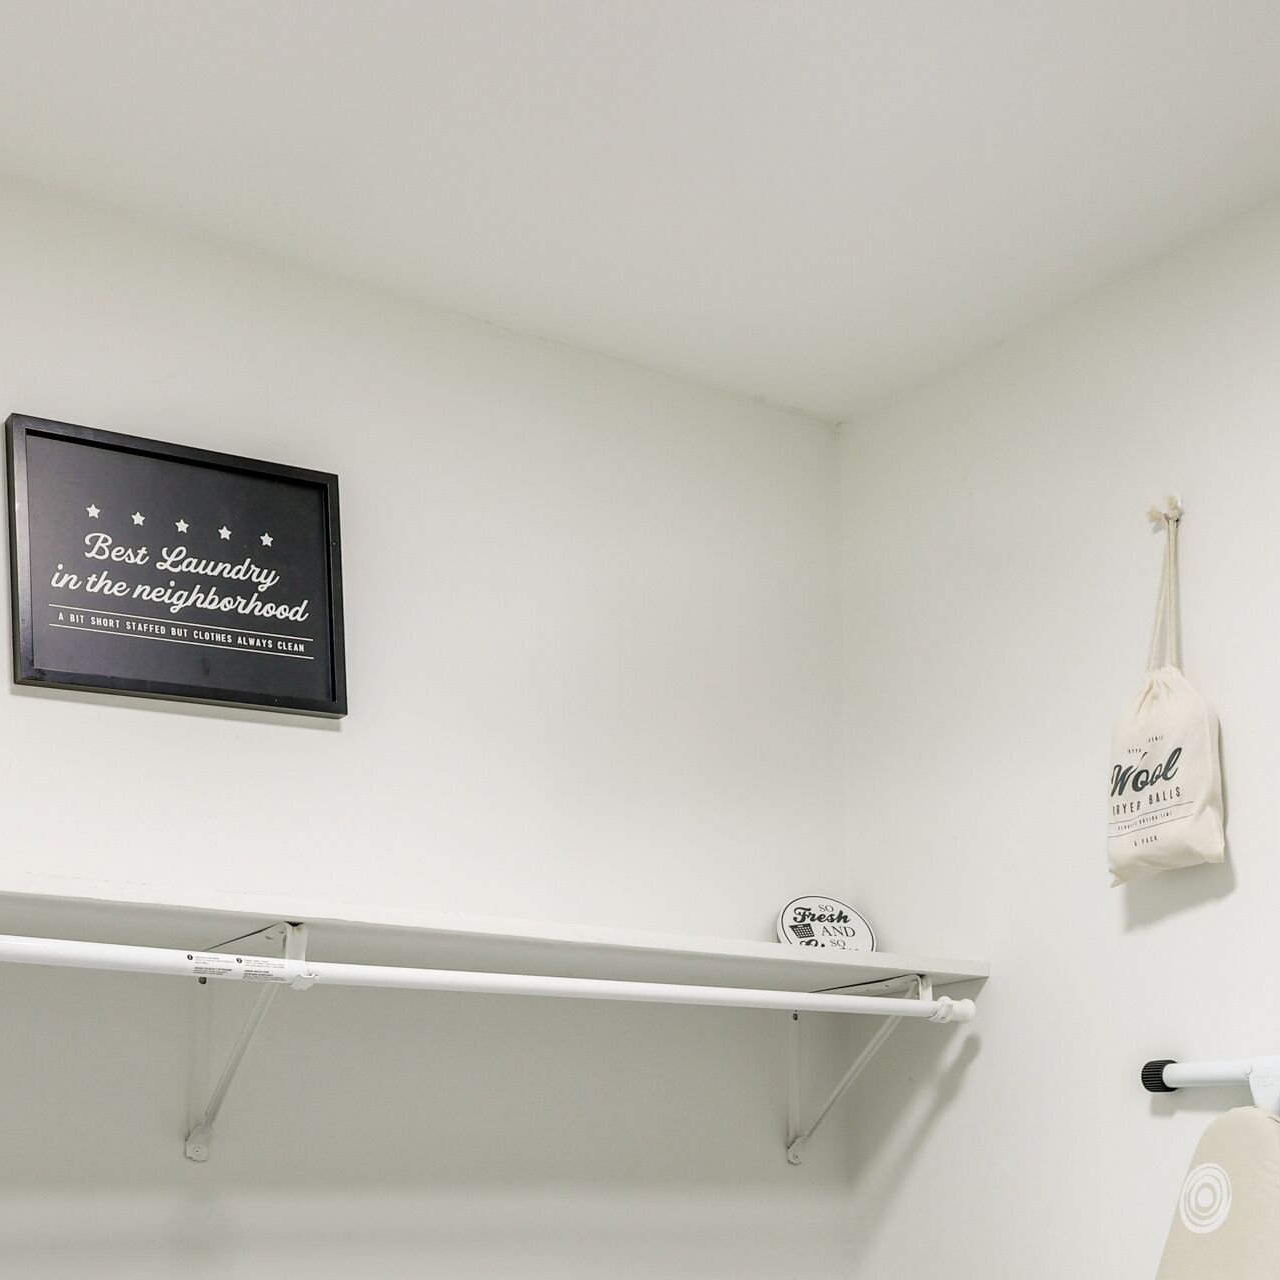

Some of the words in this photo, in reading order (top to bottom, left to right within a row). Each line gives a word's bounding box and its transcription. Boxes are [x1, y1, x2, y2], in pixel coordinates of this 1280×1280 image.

[84, 532, 149, 565] Best
[156, 546, 280, 591] Laundry
[51, 564, 82, 590] in
[85, 570, 130, 597] the
[132, 581, 309, 623] neighborhood
[58, 612, 64, 621] A
[70, 613, 85, 624] BIT
[91, 616, 120, 629] SHORT
[126, 619, 167, 635] STAFFED
[171, 626, 188, 638] BUT
[193, 629, 233, 643] CLOTHES
[237, 635, 273, 649] ALWAYS
[277, 640, 305, 653] CLEAN
[1110, 747, 1182, 798] Wool
[1149, 786, 1181, 805] BALLS
[793, 907, 851, 924] Fresh
[818, 904, 834, 913] SO
[821, 925, 856, 937] AND
[830, 939, 846, 947] SO
